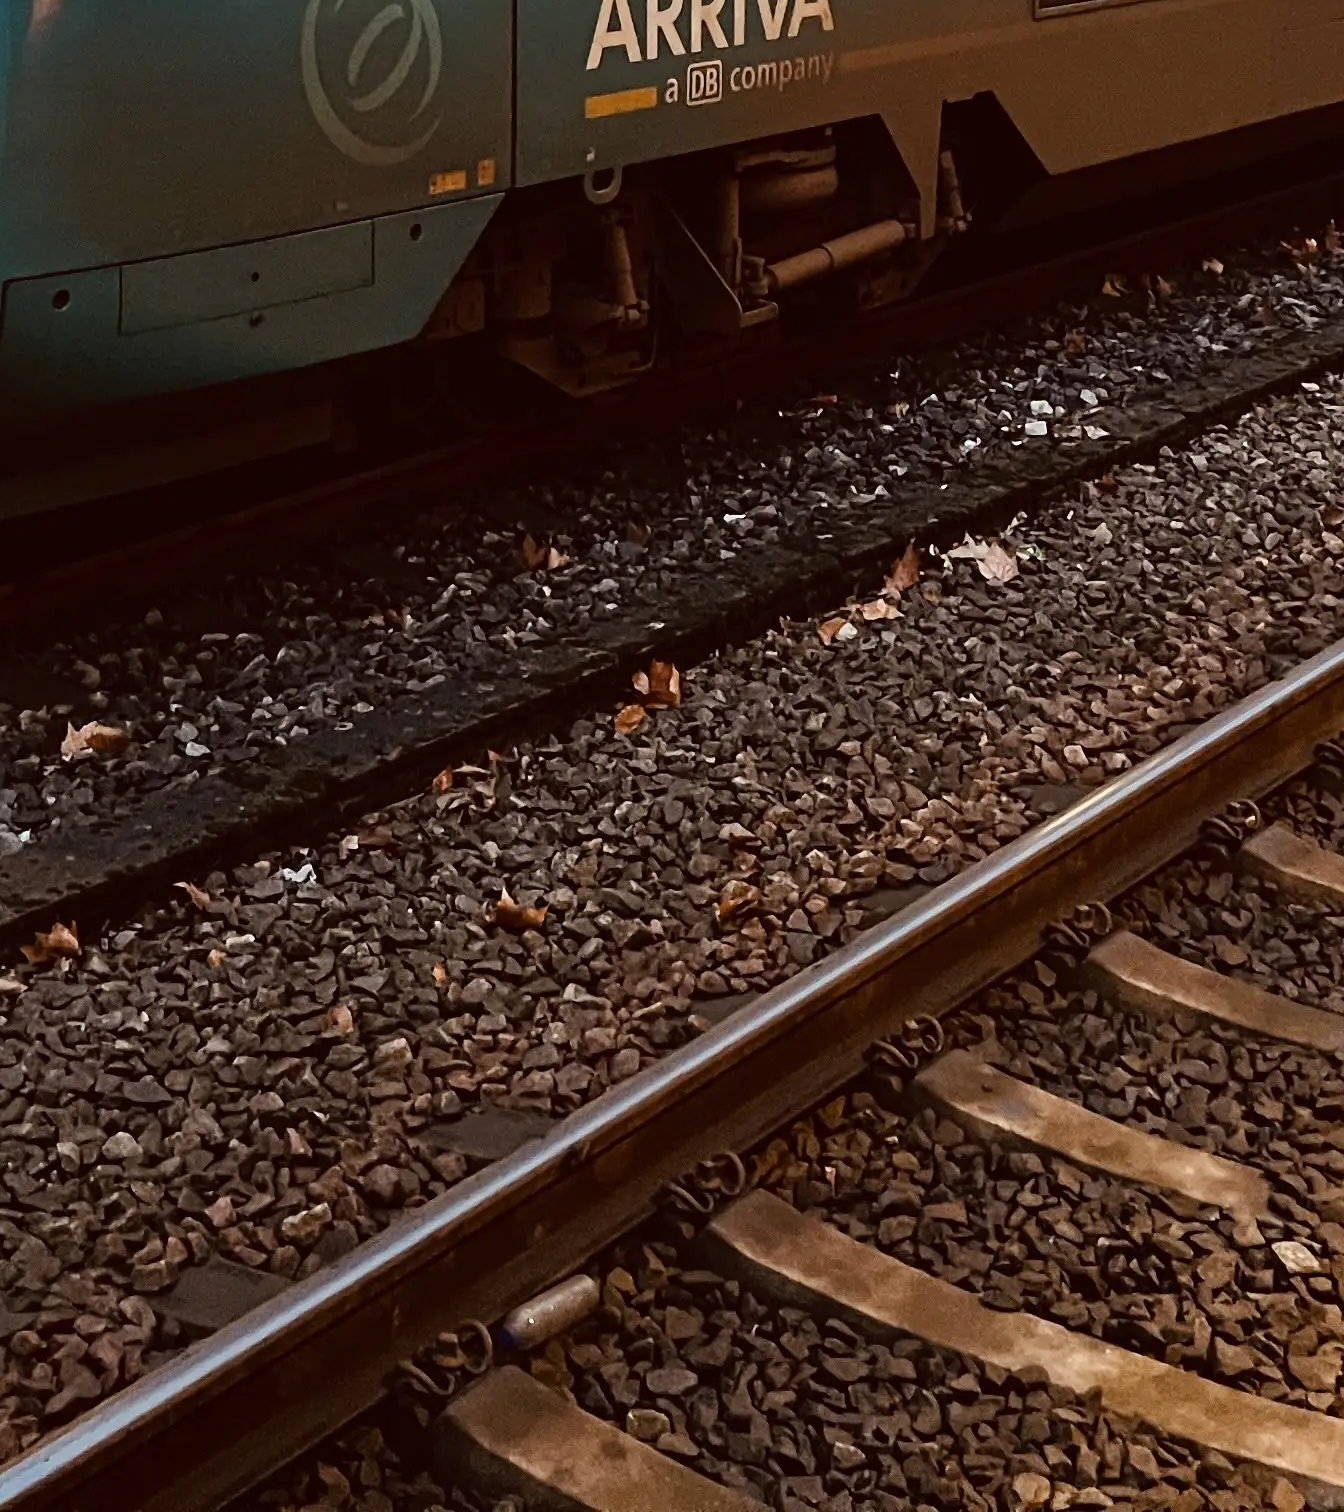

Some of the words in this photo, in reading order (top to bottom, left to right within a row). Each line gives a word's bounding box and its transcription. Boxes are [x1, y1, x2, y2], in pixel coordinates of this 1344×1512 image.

[665, 78, 678, 103] a
[689, 65, 720, 102] DB
[729, 50, 835, 92] company
